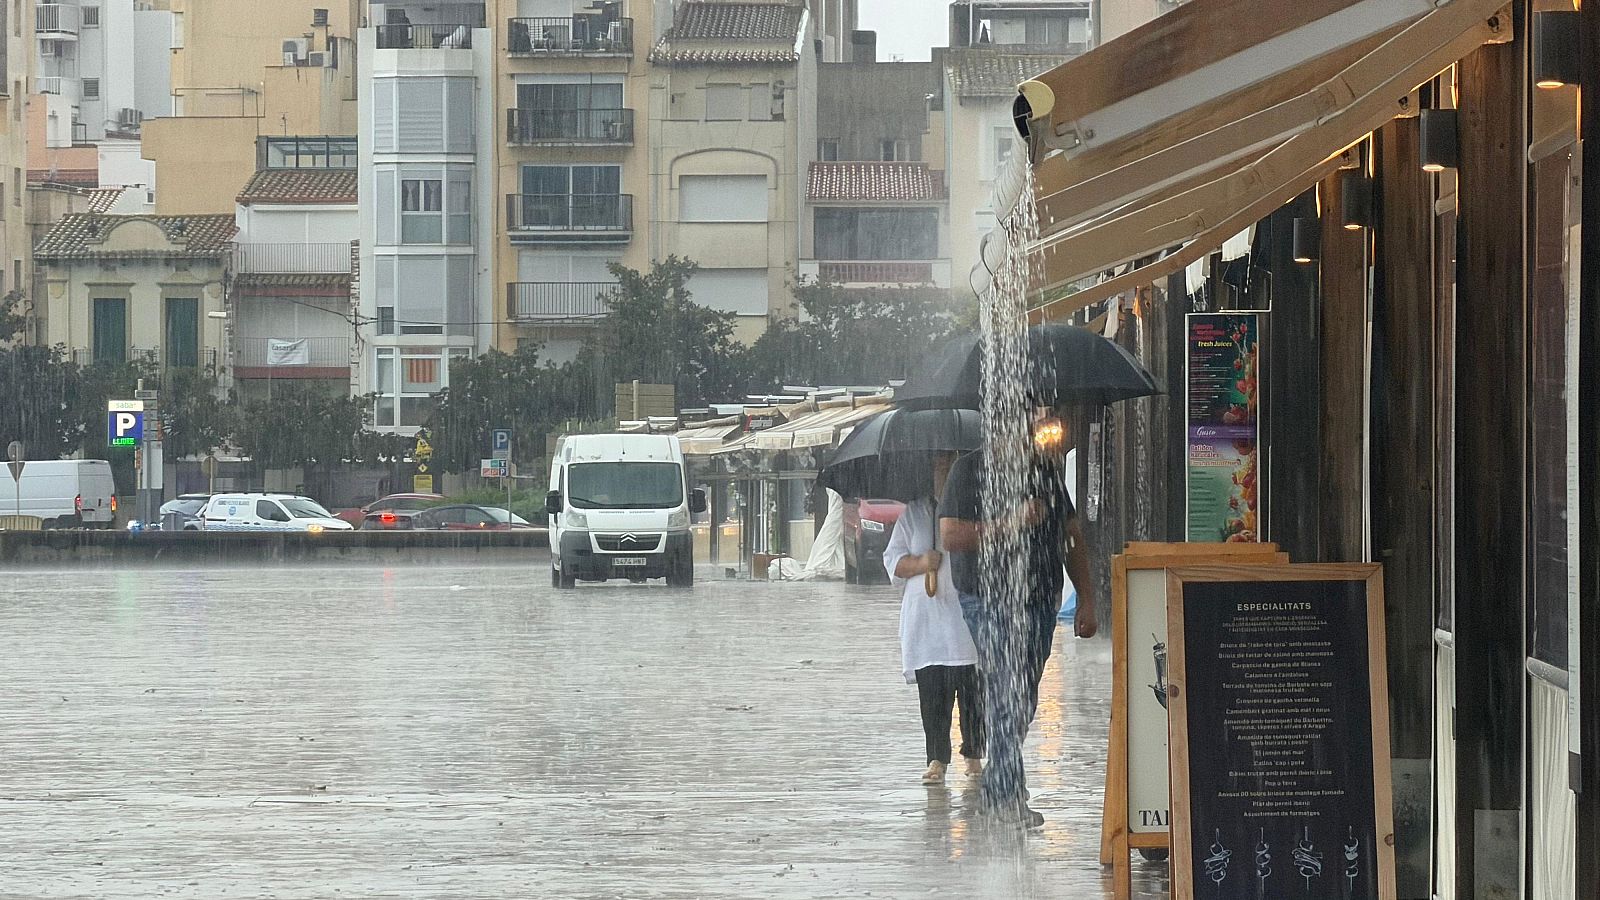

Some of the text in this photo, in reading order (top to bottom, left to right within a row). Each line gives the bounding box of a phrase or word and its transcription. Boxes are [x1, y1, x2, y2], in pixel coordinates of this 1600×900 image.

[116, 412, 136, 436] P
[496, 432, 507, 448] P
[1238, 602, 1311, 611] ESPECIALITATS
